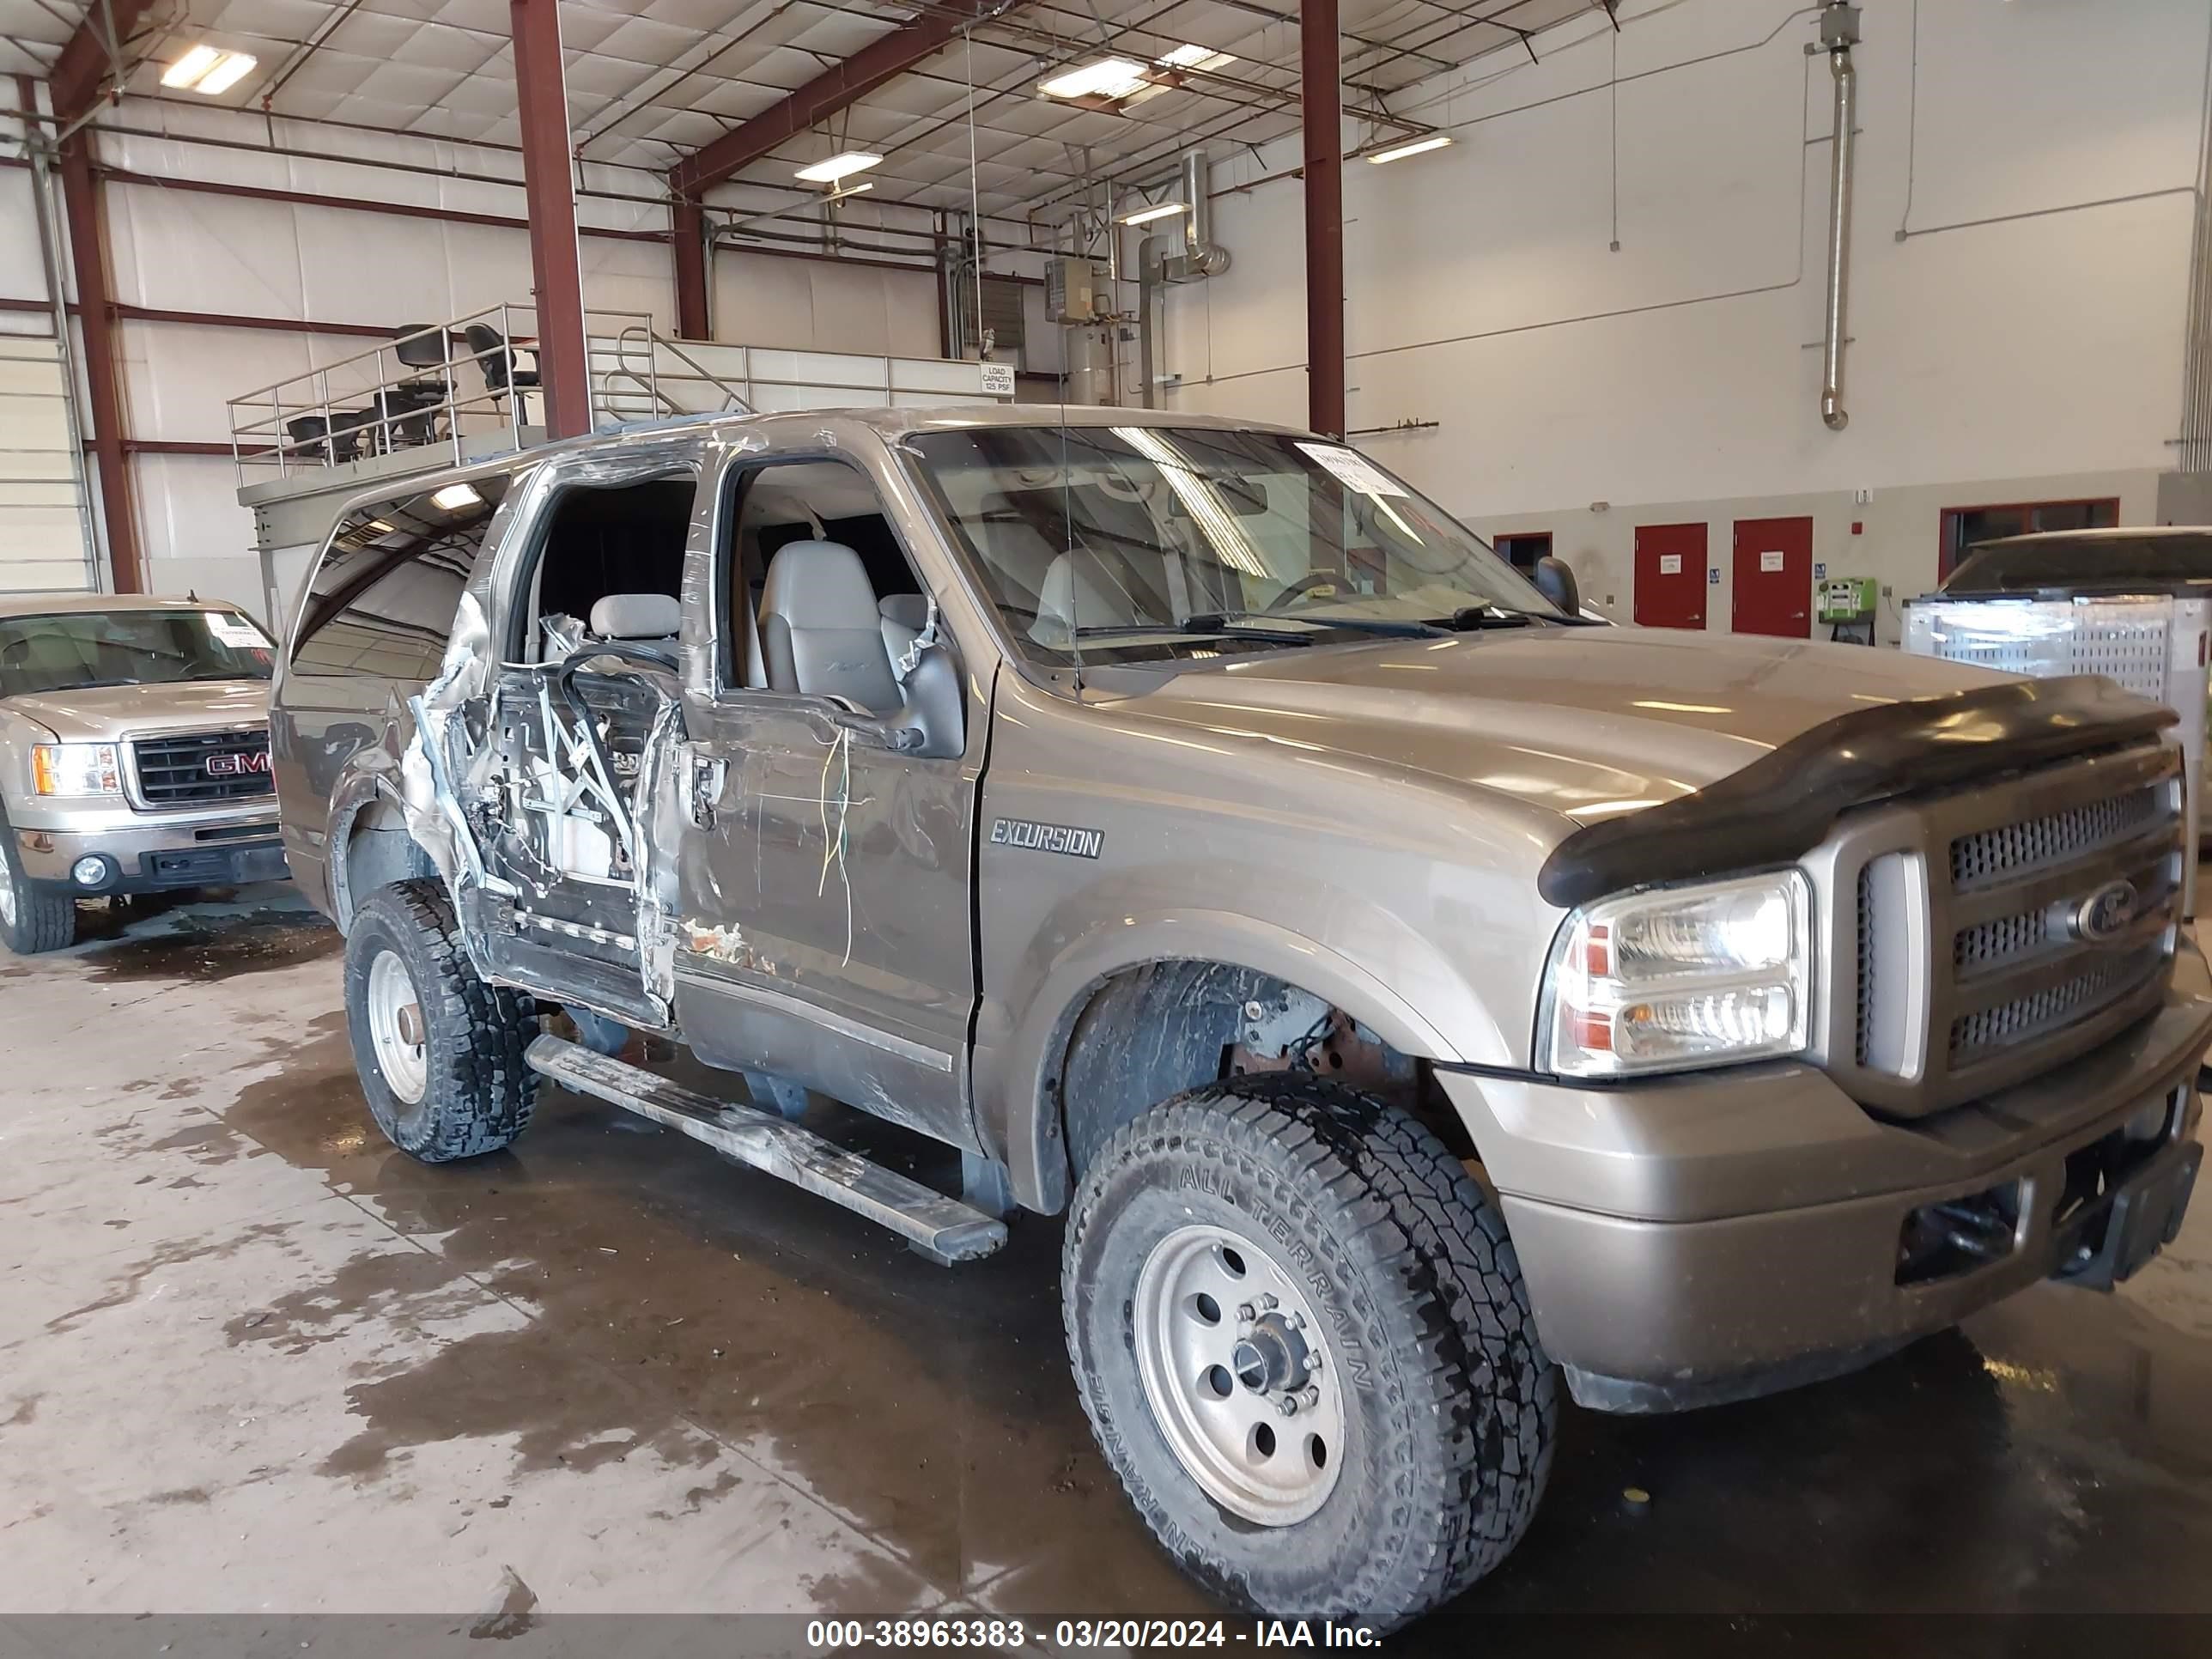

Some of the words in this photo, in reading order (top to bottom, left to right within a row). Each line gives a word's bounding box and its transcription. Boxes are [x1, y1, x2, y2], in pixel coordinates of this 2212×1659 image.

[982, 374, 1012, 384] CAPACITY
[988, 367, 1006, 375] LOAD
[205, 751, 272, 776] GM
[990, 818, 1101, 857] EXCURSION
[1180, 1164, 1235, 1205] ALL
[1249, 1195, 1373, 1389] TERRAIN
[1085, 1374, 1159, 1516] RANGE
